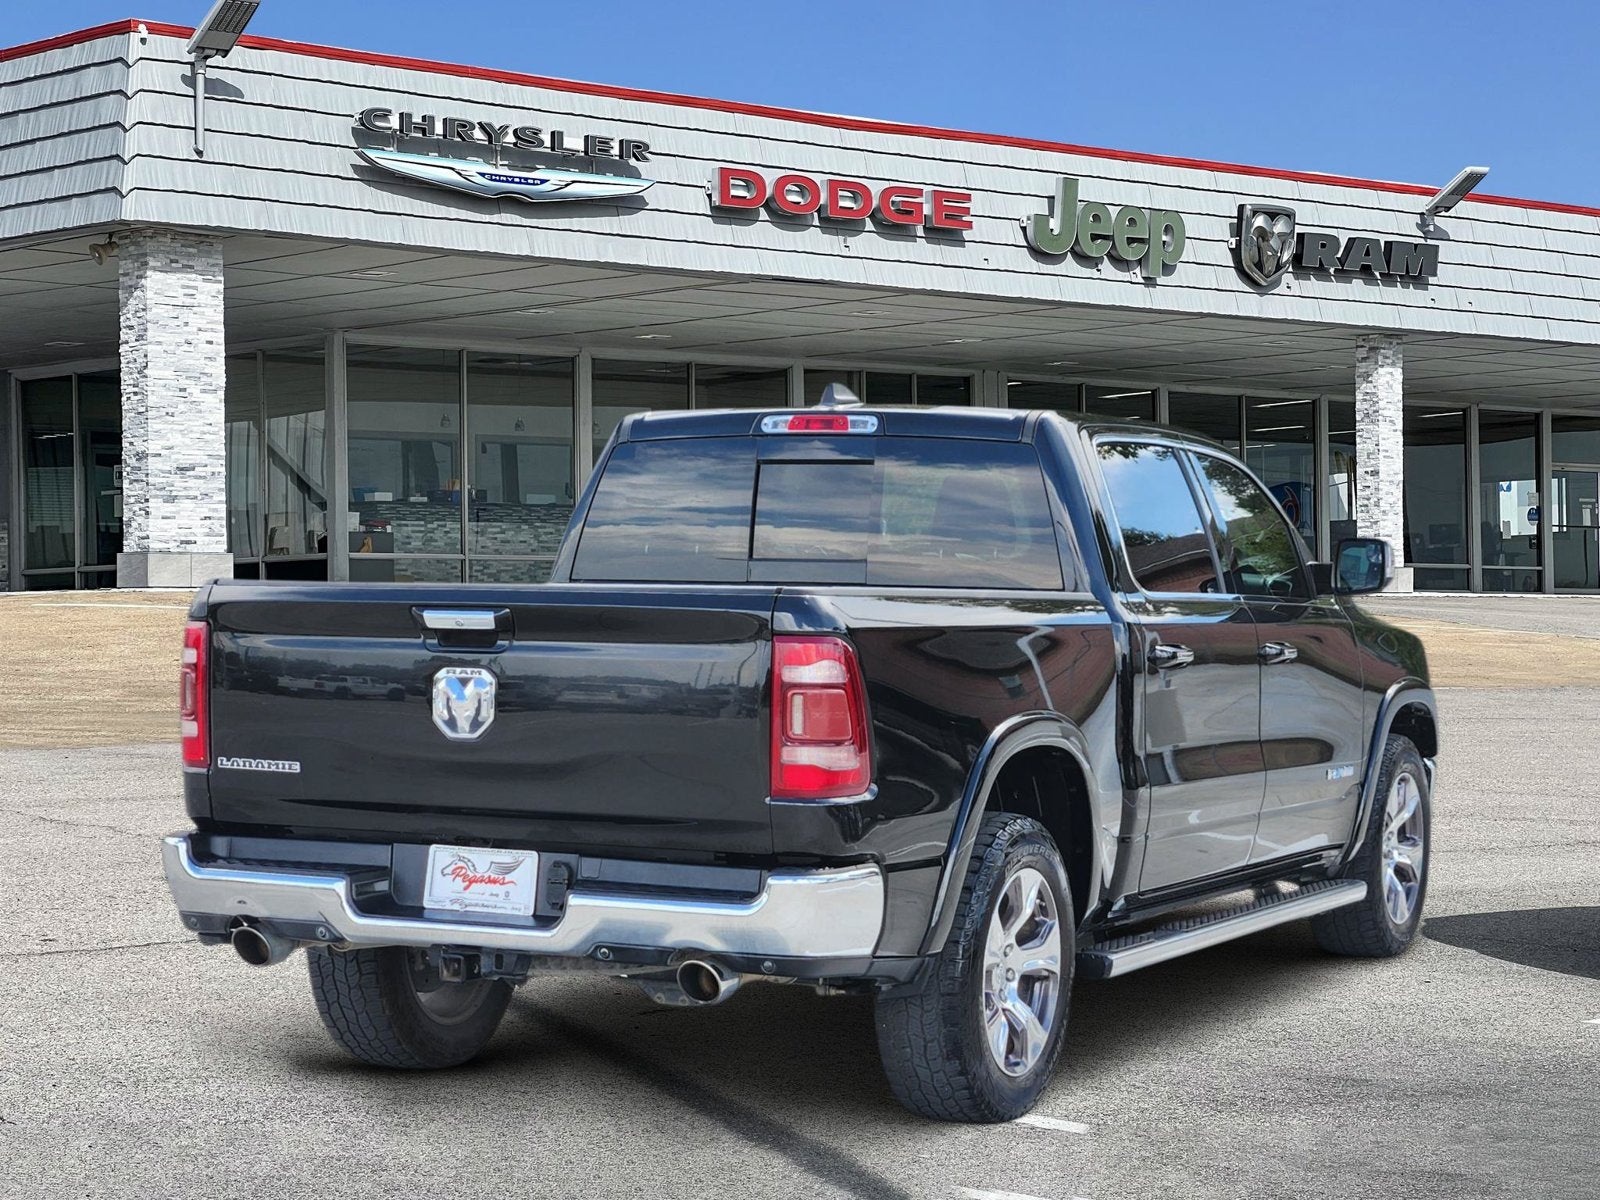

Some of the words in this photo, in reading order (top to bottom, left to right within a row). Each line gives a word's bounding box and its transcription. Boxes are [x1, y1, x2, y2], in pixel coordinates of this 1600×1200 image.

[358, 106, 652, 162] CHRYSLER
[484, 174, 541, 184] CHRYSLER
[713, 166, 974, 230] DODGE
[1029, 176, 1187, 278] Jeep
[1301, 231, 1440, 278] RAM
[446, 668, 483, 676] RAM
[218, 757, 300, 772] LARAMIE
[451, 865, 517, 891] Pegasus
